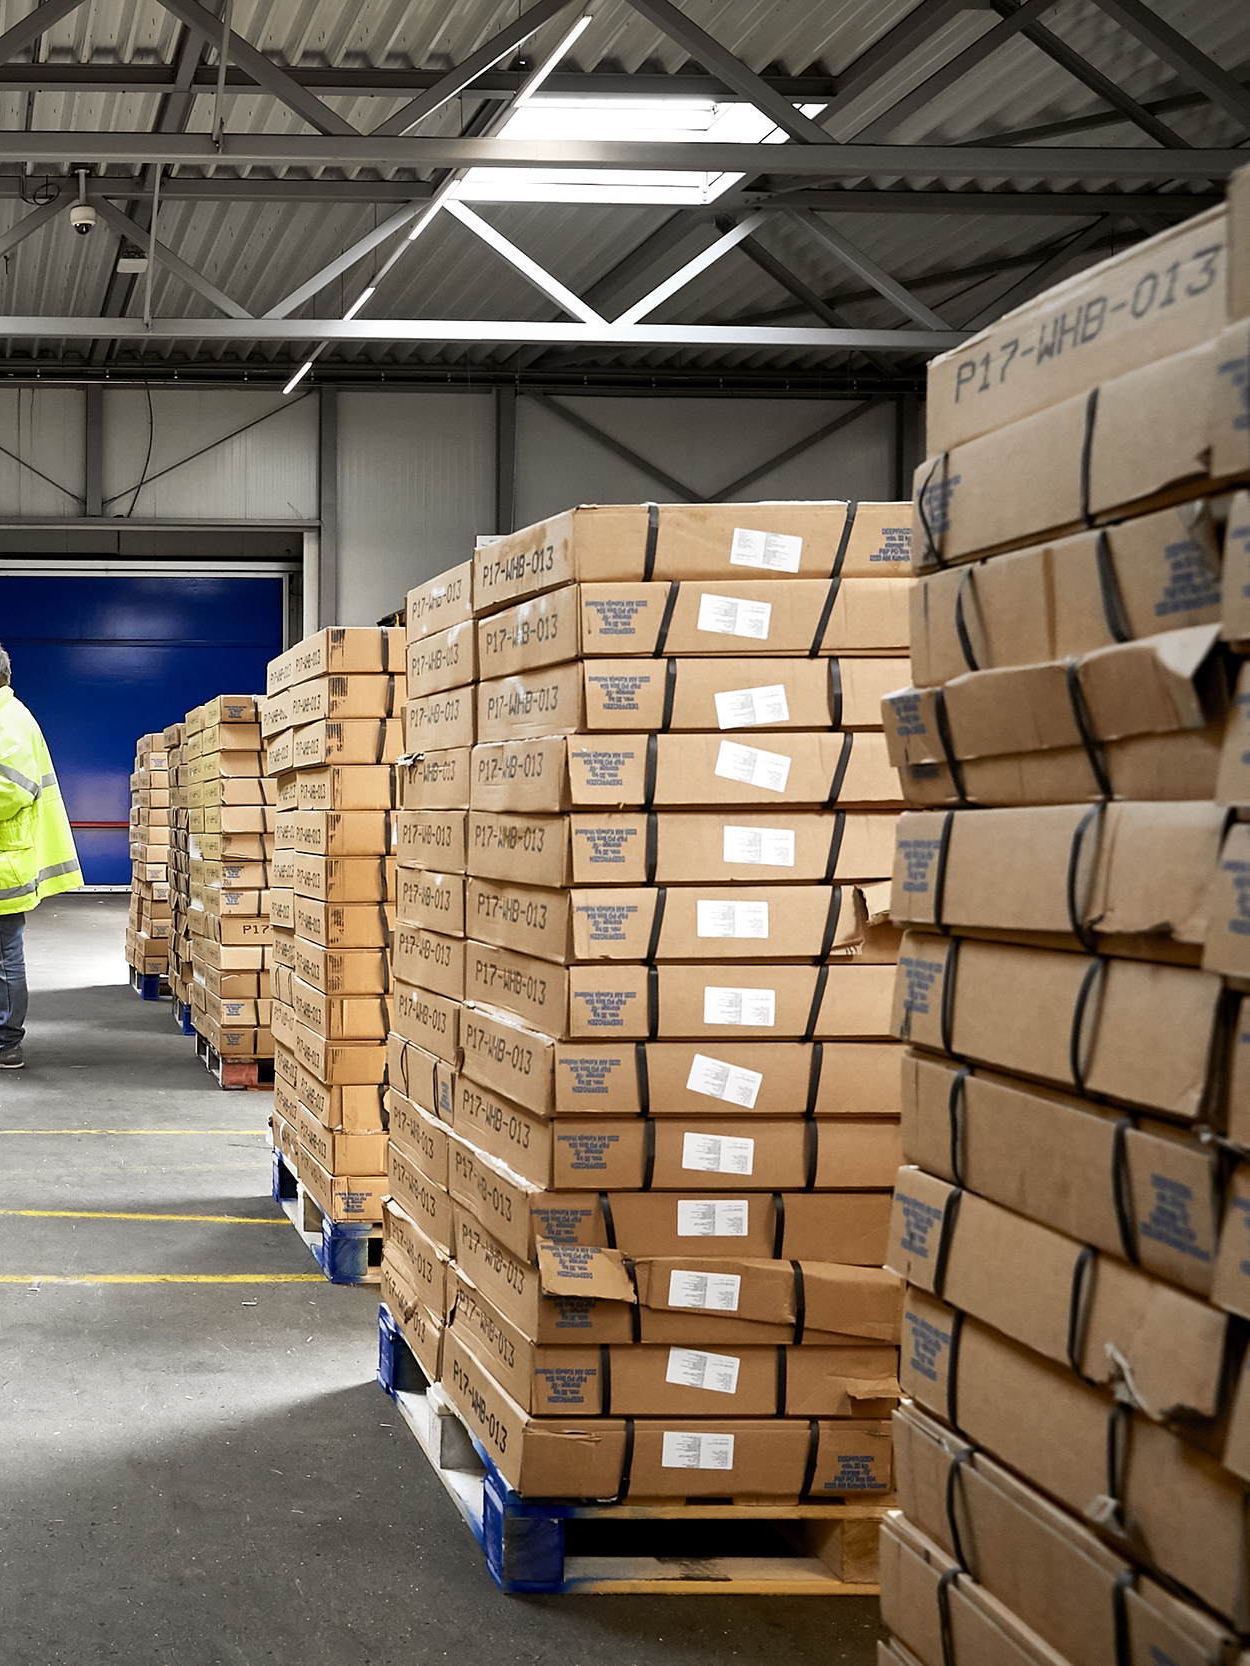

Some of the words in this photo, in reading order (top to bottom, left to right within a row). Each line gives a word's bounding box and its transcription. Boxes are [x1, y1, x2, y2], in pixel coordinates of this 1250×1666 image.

[954, 244, 1223, 403] P17-WHB-013
[483, 546, 554, 587] P17-WHB-013
[412, 643, 459, 678] P17-WHB-013
[410, 699, 460, 728] P17-WHB-013
[488, 686, 559, 720] P17-WHB-013
[478, 752, 544, 782] P17-WHB-013
[403, 824, 452, 846] P17-WHB-013
[475, 826, 545, 852] P17-WHB-013
[403, 882, 451, 911] P17-WHB-013
[478, 893, 547, 930] P17-WHB-013
[400, 933, 450, 967] P17-WHB-013
[476, 960, 546, 1005] P17-WHB-013
[399, 995, 447, 1034] P17-WHB-013
[466, 1025, 532, 1075] P17-WHB-013
[394, 1106, 434, 1160] P17-WHB-013
[463, 1090, 530, 1149] P17-WHB-013
[393, 1158, 436, 1218] P17-WHB-013
[456, 1152, 512, 1222] P17-WHB-013
[462, 1224, 524, 1295] P17-WHB-013
[454, 1360, 508, 1454] P17-WHB-013
